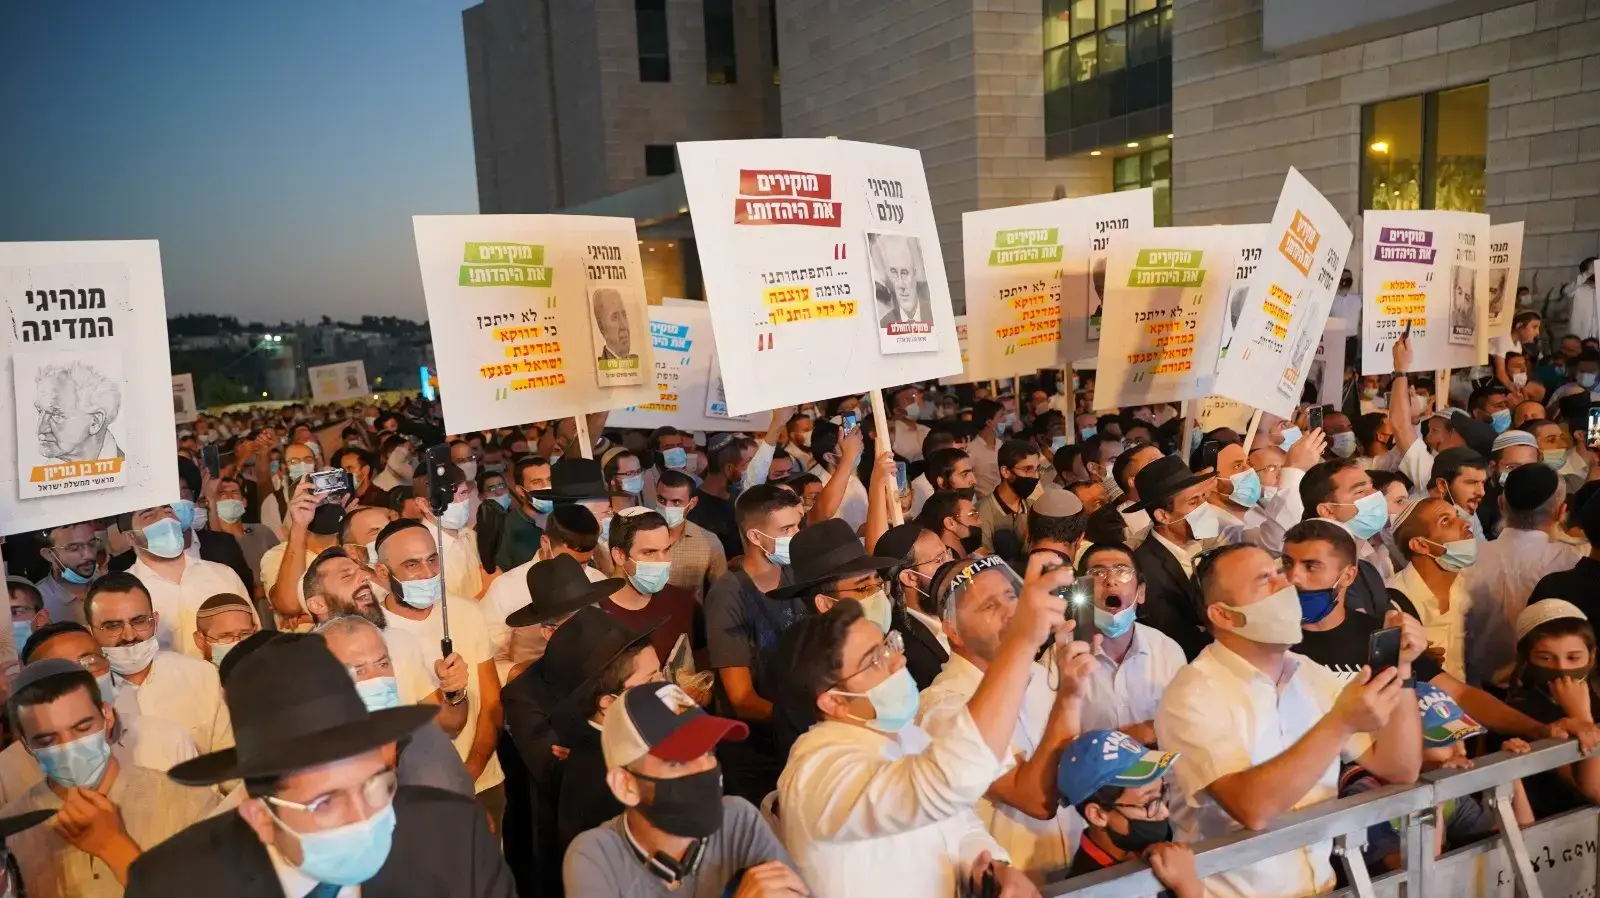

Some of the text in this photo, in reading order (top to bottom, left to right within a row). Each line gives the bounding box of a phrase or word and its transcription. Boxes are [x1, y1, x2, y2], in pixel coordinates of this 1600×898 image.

[757, 174, 819, 197] מוקירים
[867, 178, 903, 199] מנהיגי
[745, 202, 835, 220] את היהדות!
[877, 201, 904, 224] עולם
[1006, 229, 1048, 246] מוקירים
[1389, 230, 1425, 245] מוקירים
[479, 245, 533, 264] מוקירים
[588, 245, 621, 261] מנהיגי
[997, 246, 1057, 263] את היהדות!
[1381, 247, 1432, 260] את היהדות!
[1490, 242, 1509, 252] מנהי
[1149, 251, 1192, 268] מוקירים
[1489, 254, 1509, 264] המדי
[469, 267, 546, 283] את היהדות!
[588, 265, 627, 281] המדינה
[761, 266, 833, 284] התפתחותנו
[1137, 270, 1199, 284] את היהדות!
[999, 285, 1027, 300] ייתכן
[1032, 280, 1045, 292] לא
[1390, 280, 1416, 289] אלמלא
[25, 288, 106, 312] מנהיגי
[768, 284, 851, 304] כאומה עוצבה
[1014, 293, 1061, 309] כי דווקא
[521, 308, 538, 323] לא
[816, 304, 835, 316] ידי
[839, 300, 854, 315] על
[1022, 306, 1061, 320] במדינת
[1170, 305, 1183, 318] לא
[477, 313, 514, 329] ייתכן
[1135, 310, 1165, 323] ייתכן
[22, 316, 114, 343] המדינה
[500, 325, 558, 343] כי דווקא
[996, 318, 1062, 339] ישראל יפגעו
[1149, 320, 1196, 335] כי דווקא
[1156, 333, 1194, 347] במדינת
[513, 341, 561, 357] במדינת
[1127, 347, 1193, 365] ישראל יפגעו
[480, 358, 562, 379] ישראל יפגעו
[43, 460, 114, 481] דוד בן גוריון
[38, 476, 115, 492] מראשי ממשלת ישראל
